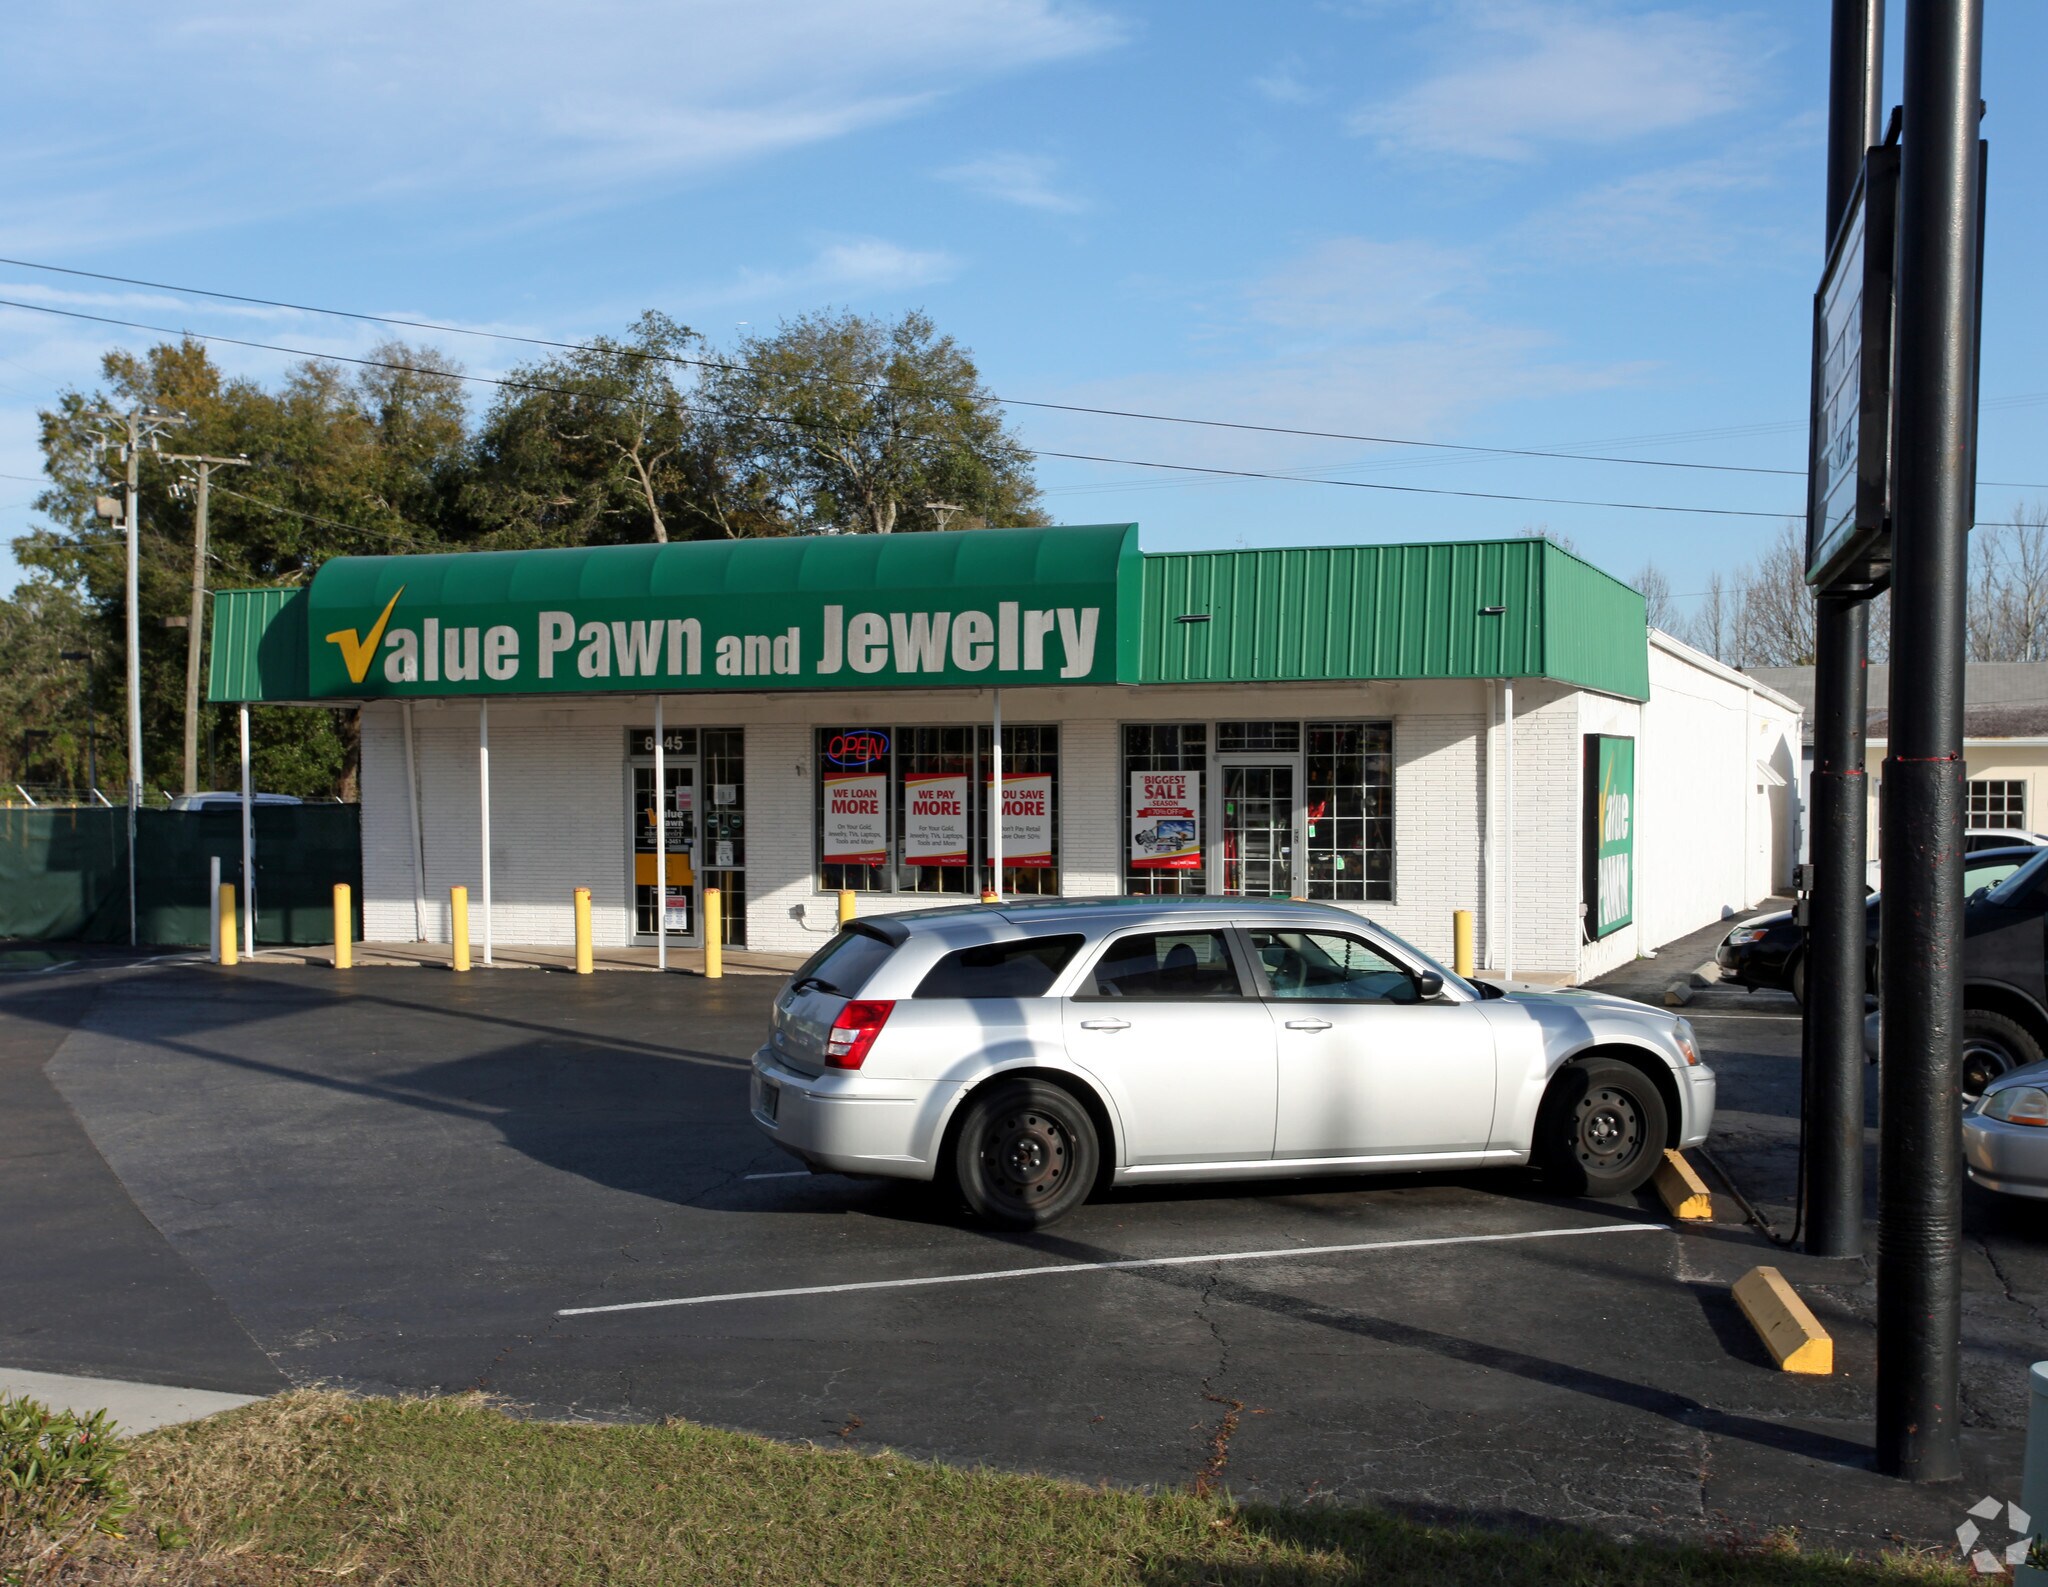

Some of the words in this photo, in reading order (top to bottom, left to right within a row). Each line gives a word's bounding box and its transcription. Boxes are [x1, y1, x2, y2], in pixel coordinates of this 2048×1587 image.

[538, 610, 702, 679] Pawn
[715, 626, 800, 676] and
[817, 601, 1100, 679] Jewelry
[645, 736, 683, 751] 845
[829, 735, 885, 760] OPEN
[1144, 775, 1186, 785] BIGGEST
[833, 789, 848, 798] WE
[851, 789, 877, 798] LOAN
[918, 790, 934, 799] WE
[936, 790, 955, 799] PAY
[1002, 790, 1017, 799] OU
[1019, 790, 1044, 799] SAVE
[1144, 785, 1186, 799] SALE
[831, 800, 879, 814] MORE
[912, 801, 961, 815] MORE
